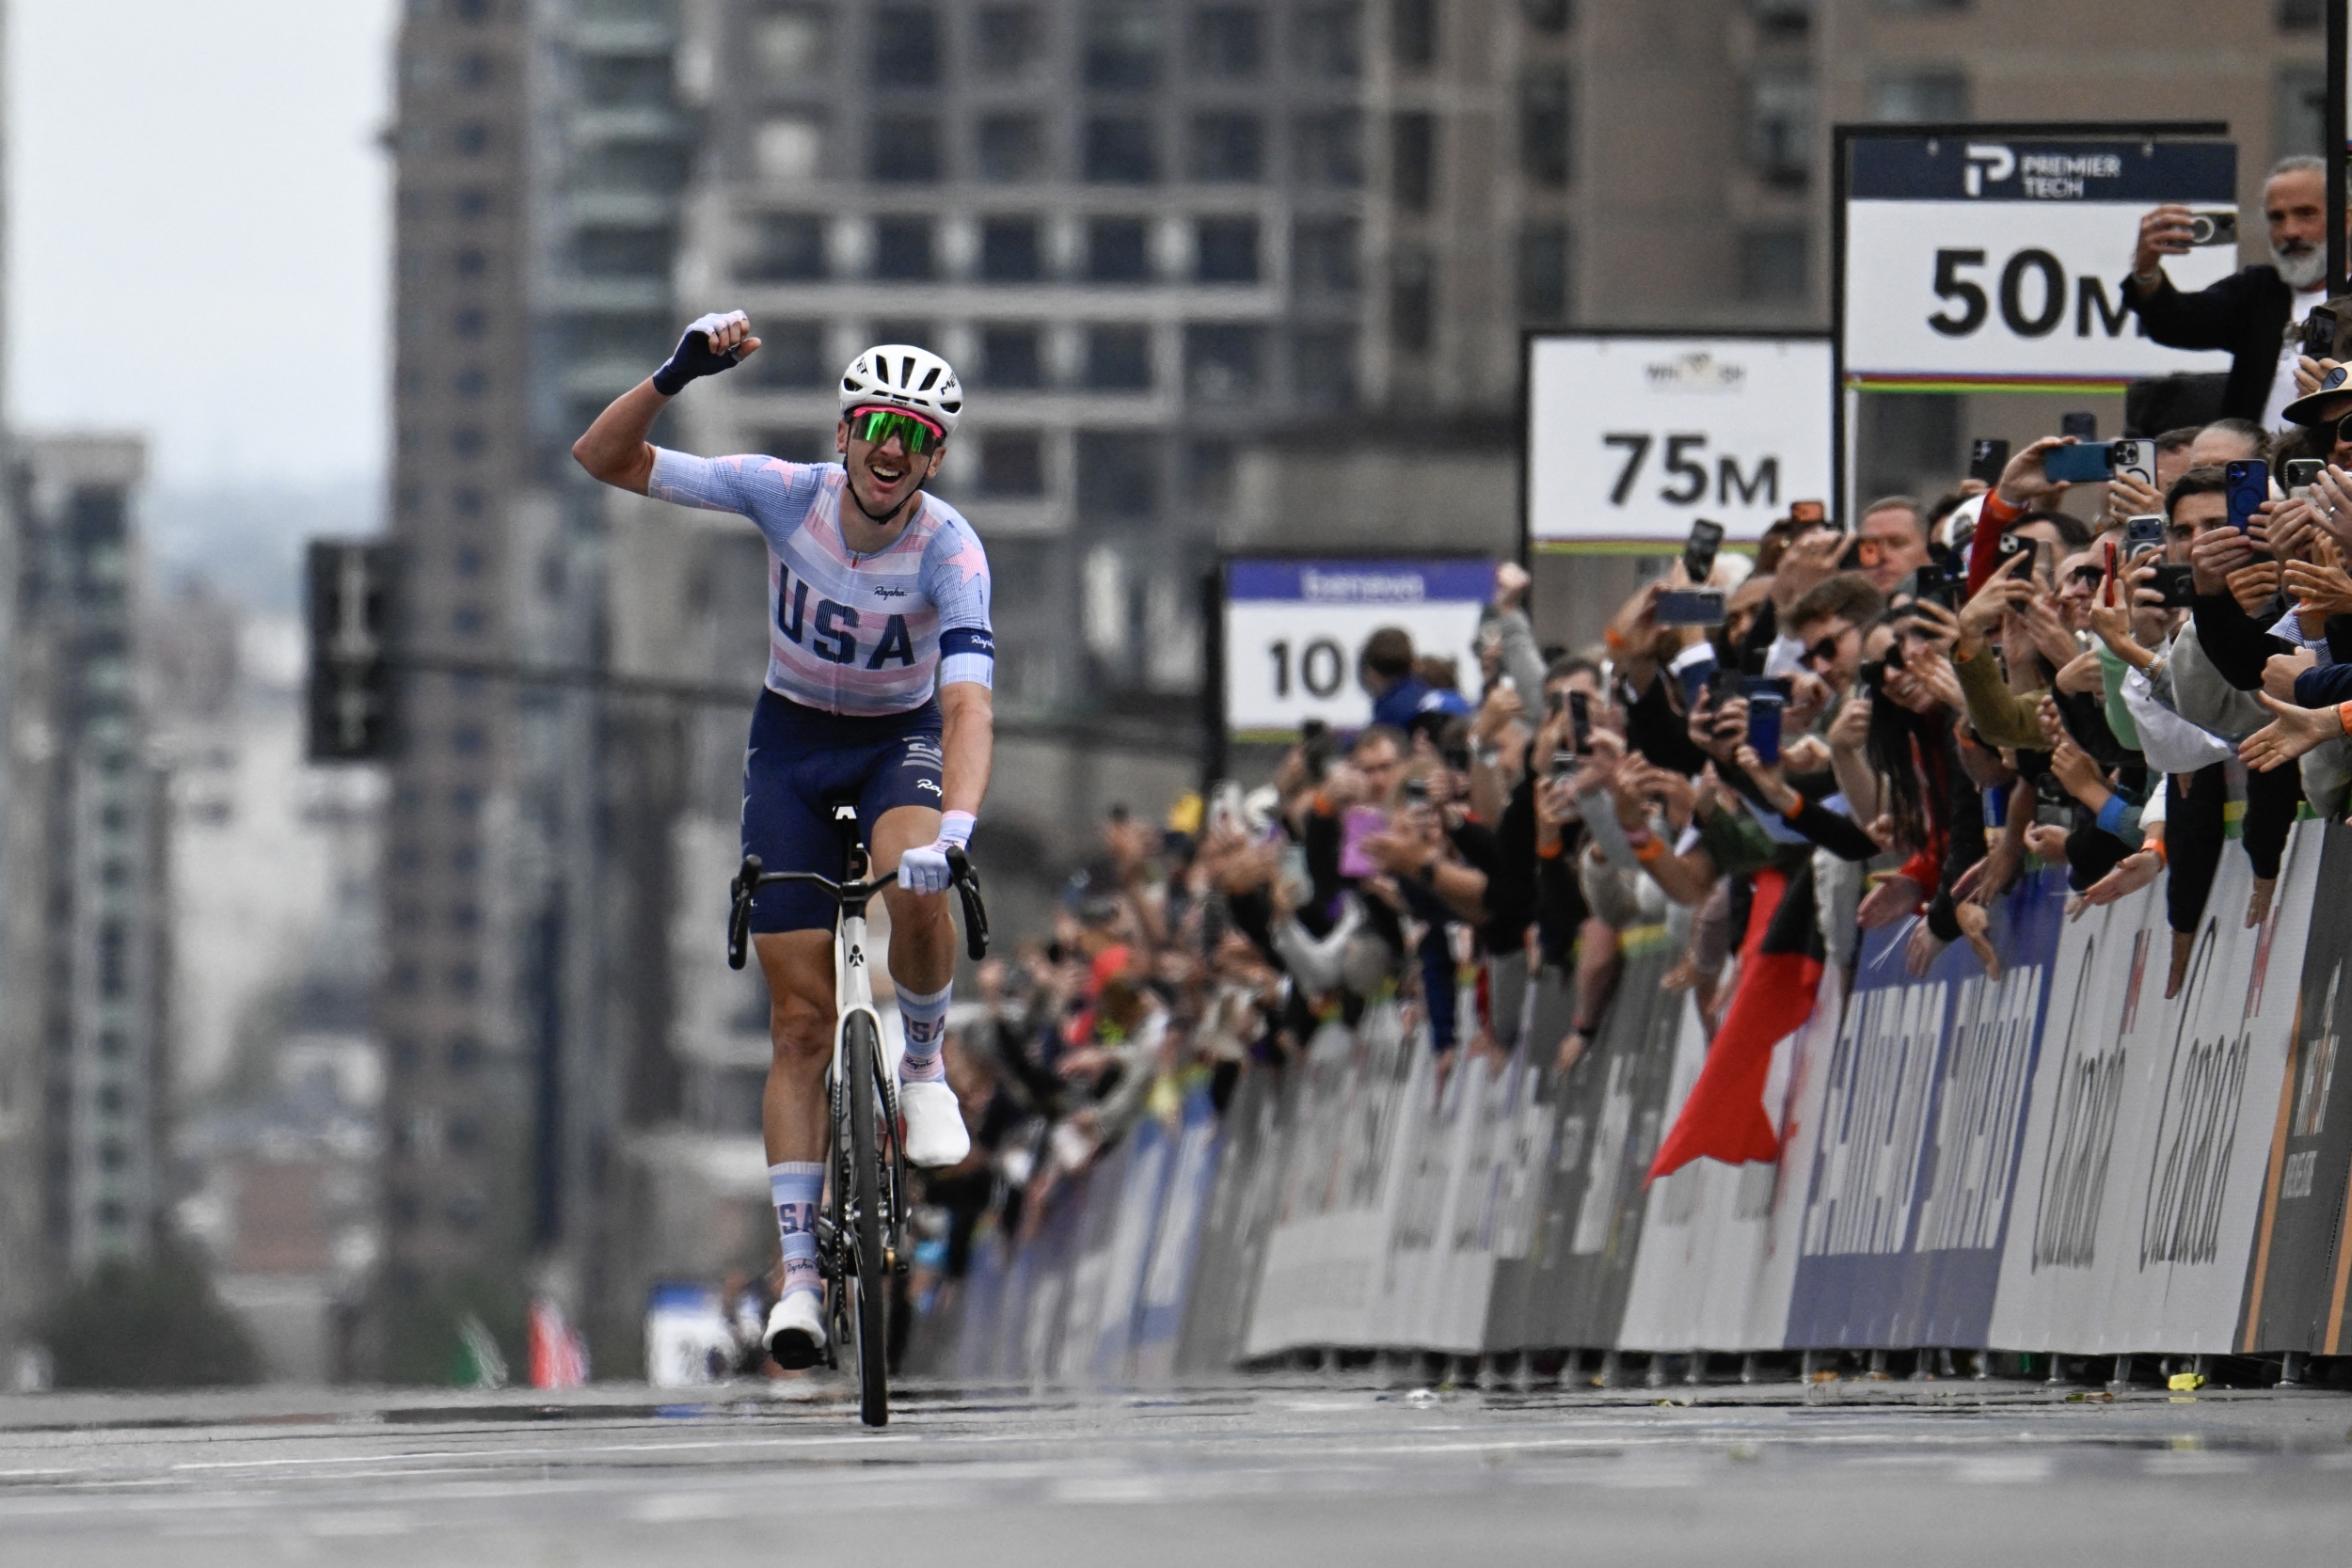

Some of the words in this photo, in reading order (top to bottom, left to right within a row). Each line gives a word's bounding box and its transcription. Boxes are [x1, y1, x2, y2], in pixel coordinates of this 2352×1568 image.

[2022, 154, 2122, 178] PREMIER
[2024, 178, 2085, 198] TECH
[1602, 434, 1779, 507] 75M
[777, 562, 916, 670] USA
[1270, 639, 1371, 698] 10
[2138, 914, 2261, 1275] Canada
[779, 1203, 817, 1235] SA
